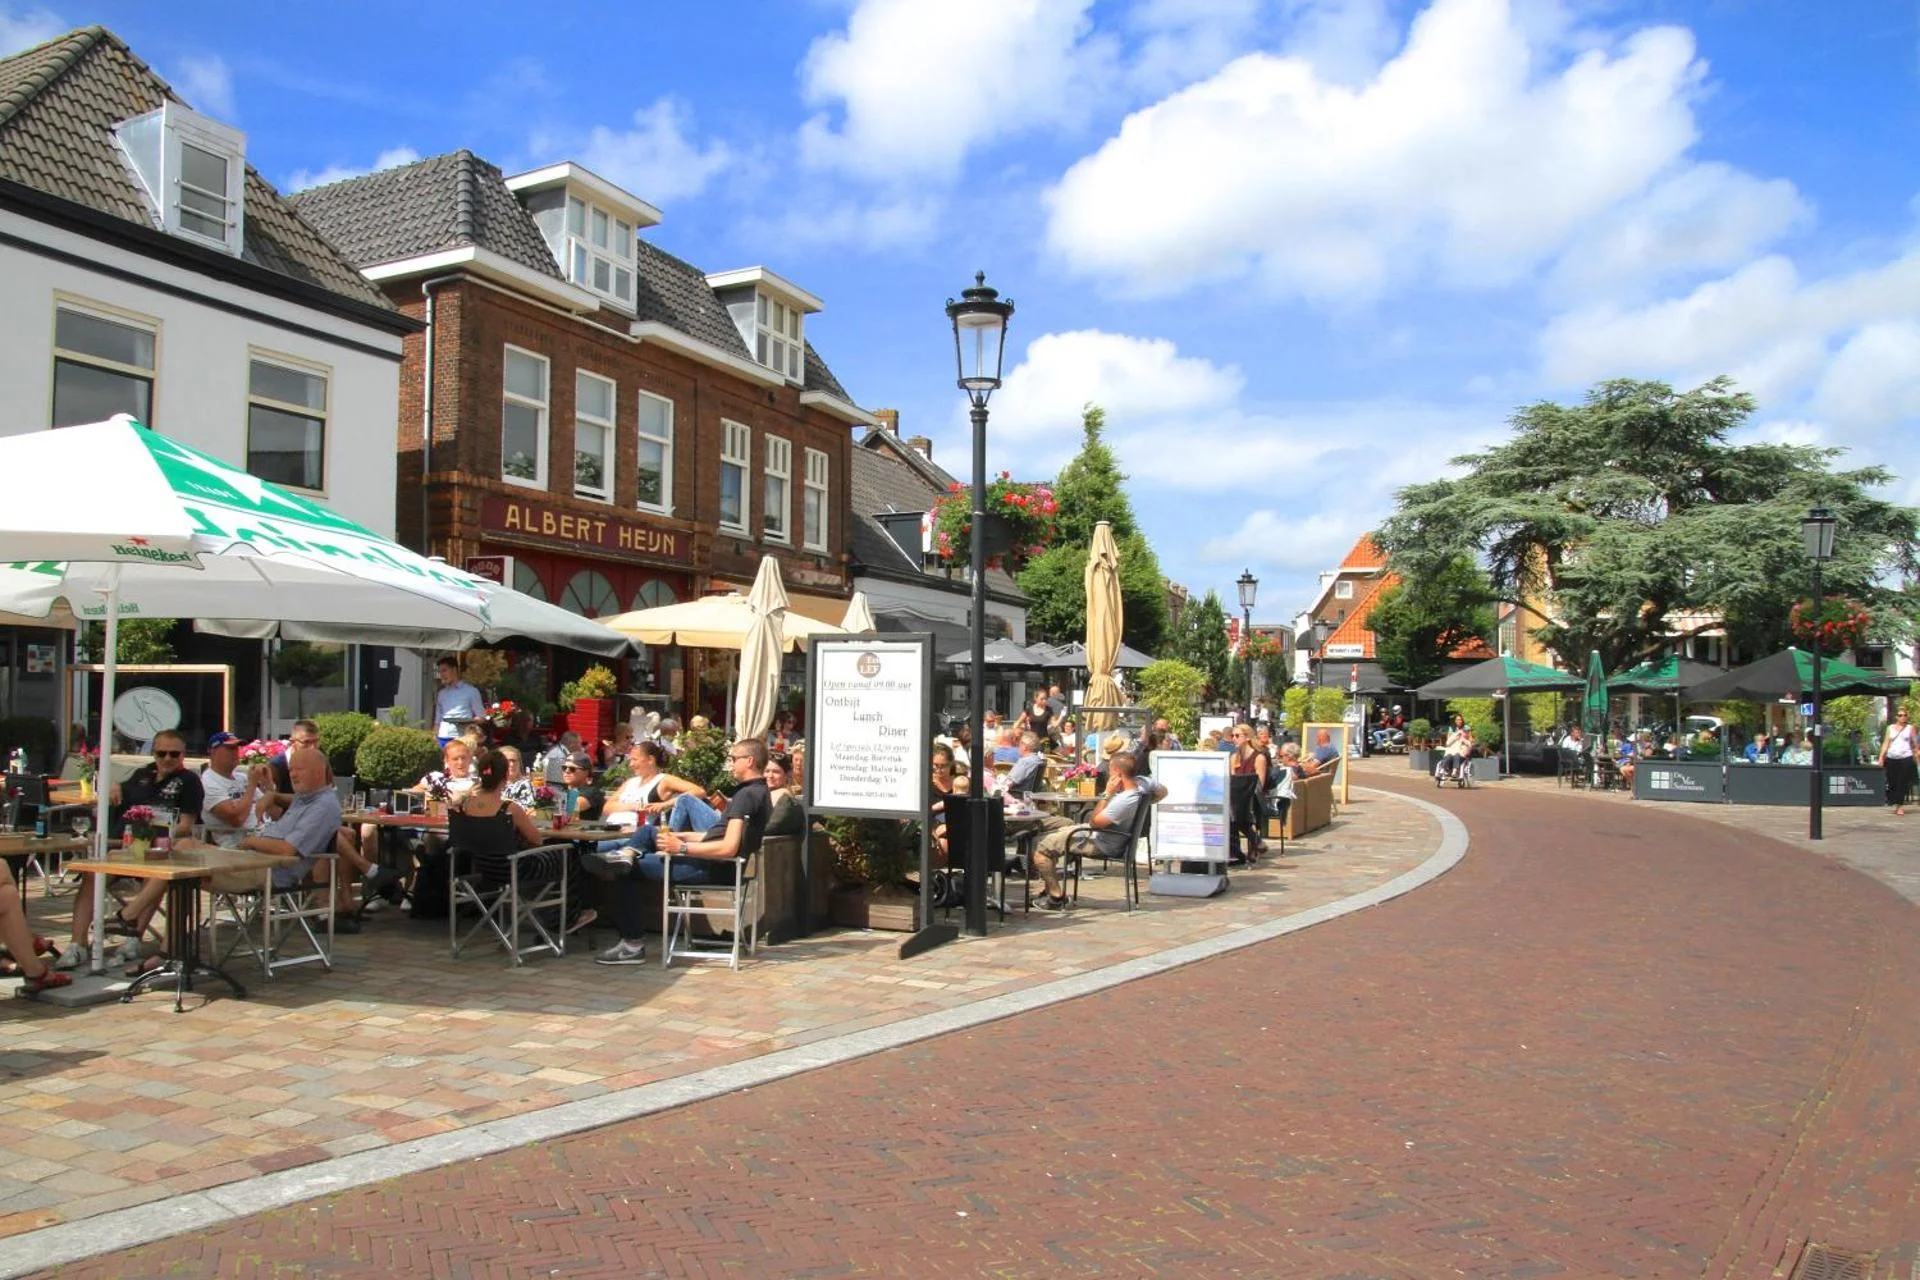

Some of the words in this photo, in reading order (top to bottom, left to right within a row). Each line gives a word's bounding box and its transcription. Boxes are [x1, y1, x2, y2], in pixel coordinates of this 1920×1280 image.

[505, 505, 606, 544] ALBERT
[111, 545, 194, 562] Heineken
[825, 696, 860, 709] Ontbijt
[853, 712, 883, 722] Lunch
[879, 725, 907, 738] Diner
[884, 775, 897, 784] Vis
